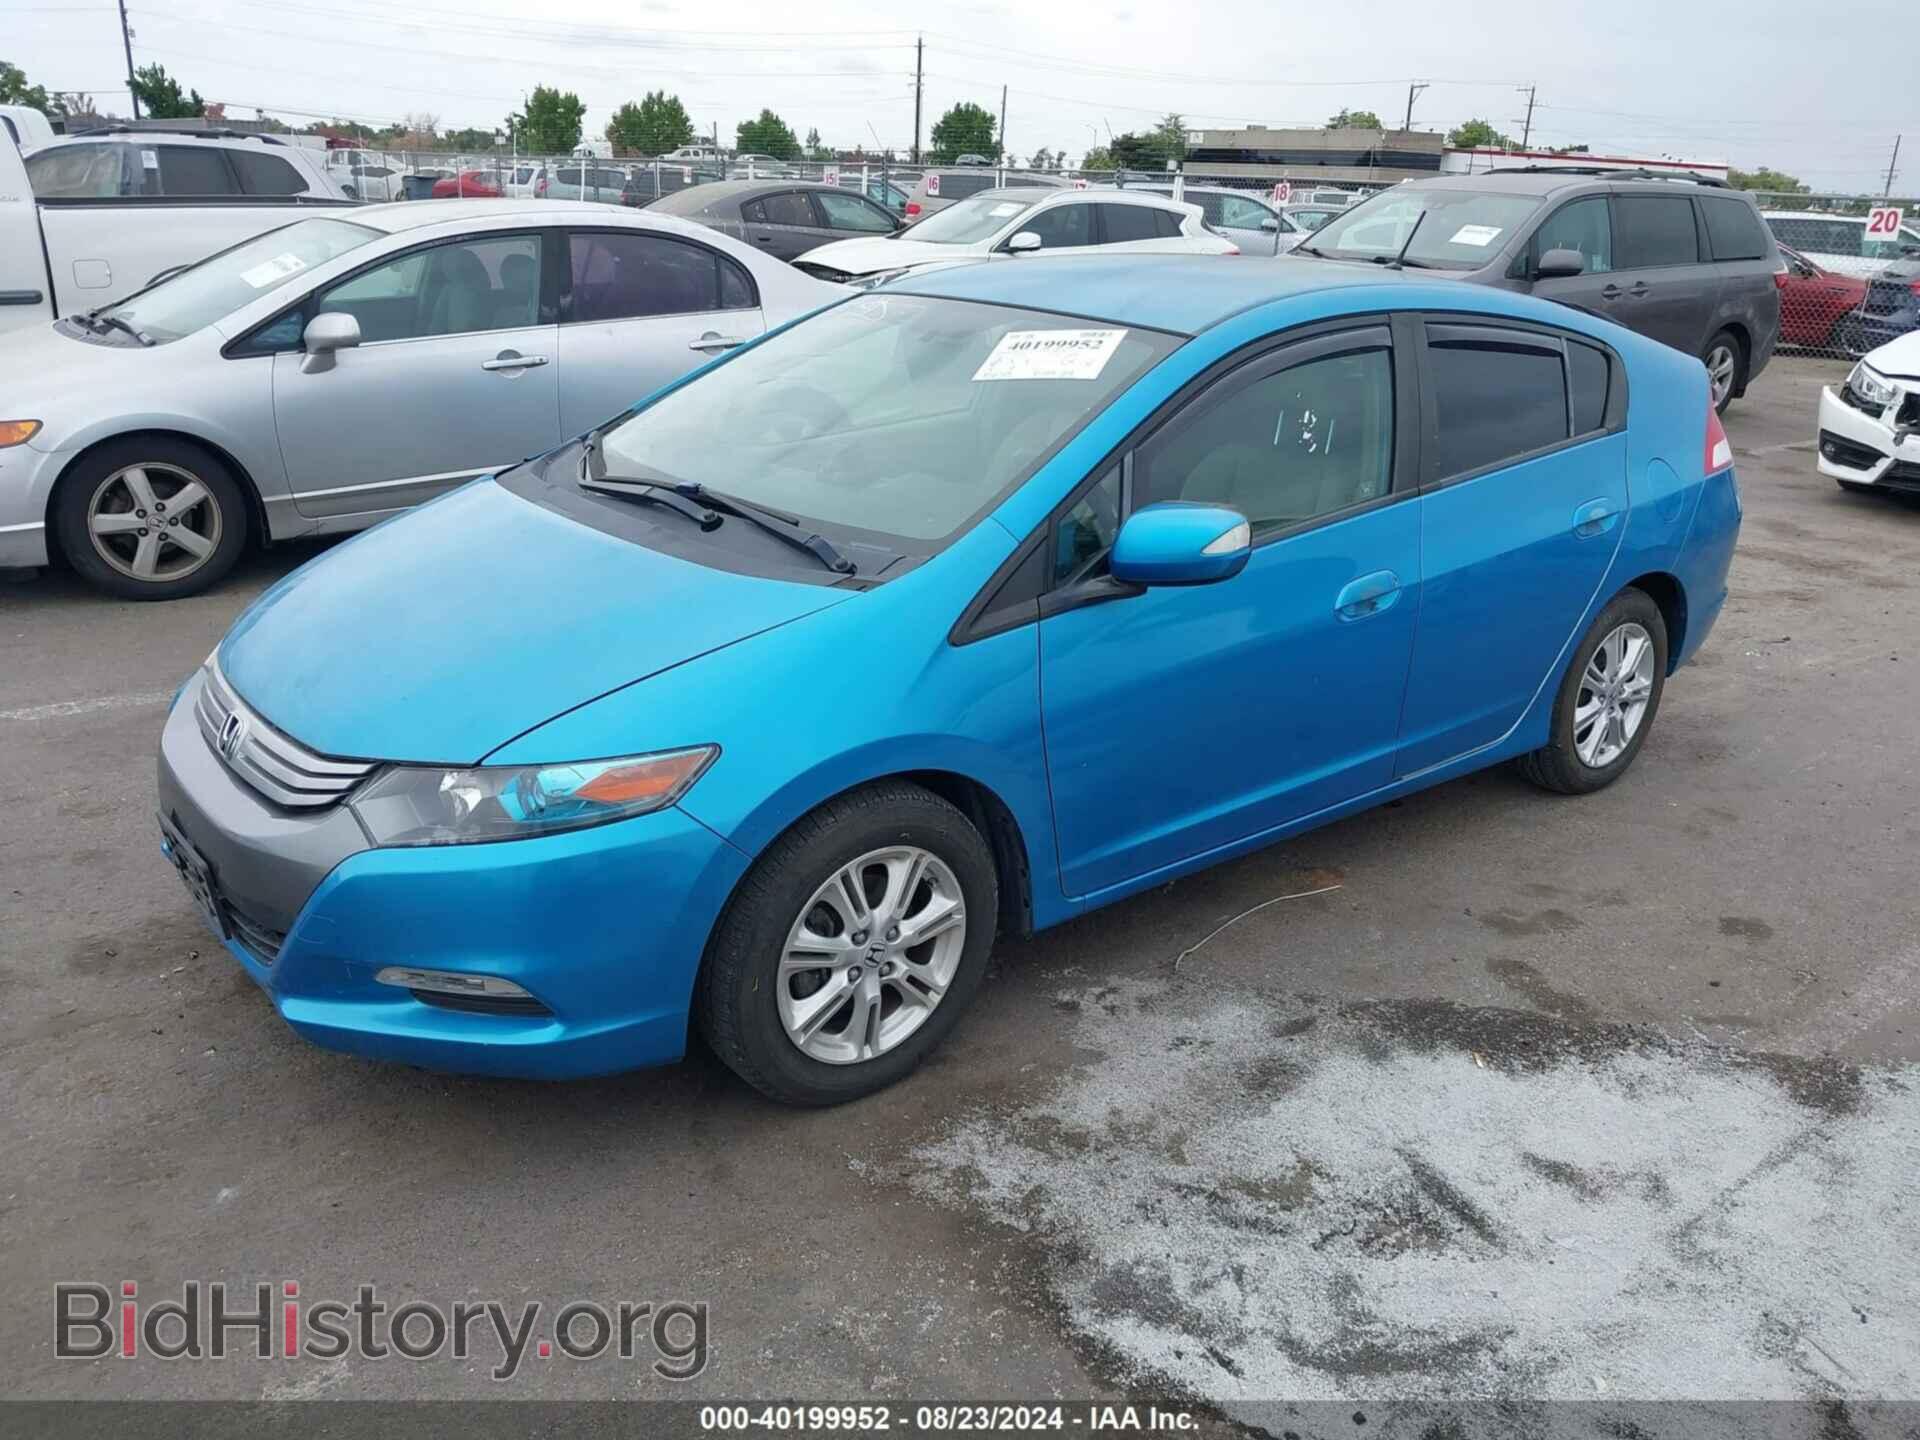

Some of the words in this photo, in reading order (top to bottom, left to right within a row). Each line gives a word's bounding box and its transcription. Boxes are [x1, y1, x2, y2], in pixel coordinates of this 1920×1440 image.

[928, 176, 939, 190] 16
[1275, 184, 1288, 201] 18
[1869, 210, 1899, 232] 20
[1007, 339, 1104, 351] 40199952
